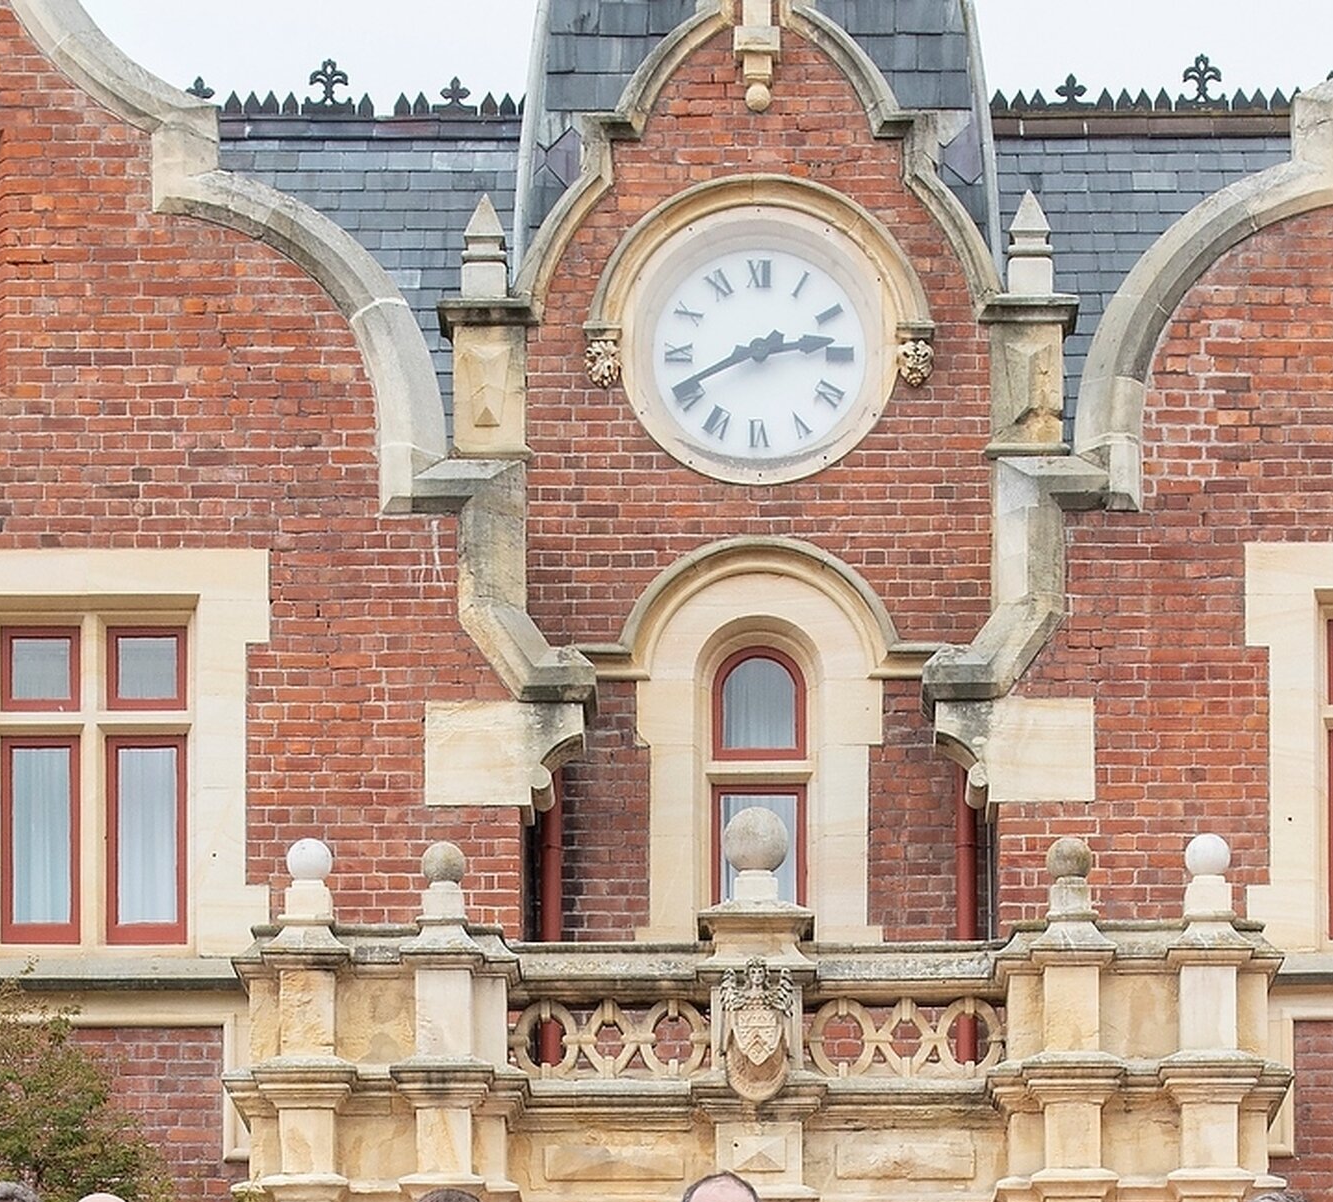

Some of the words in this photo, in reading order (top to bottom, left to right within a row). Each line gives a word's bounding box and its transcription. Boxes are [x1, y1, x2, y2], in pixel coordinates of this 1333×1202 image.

[703, 268, 734, 302] XI
[746, 260, 772, 288] XII
[791, 271, 810, 299] I
[673, 301, 705, 326] X
[664, 342, 693, 363] IX
[815, 379, 846, 409] IV
[749, 419, 770, 447] VI
[792, 411, 813, 439] V
